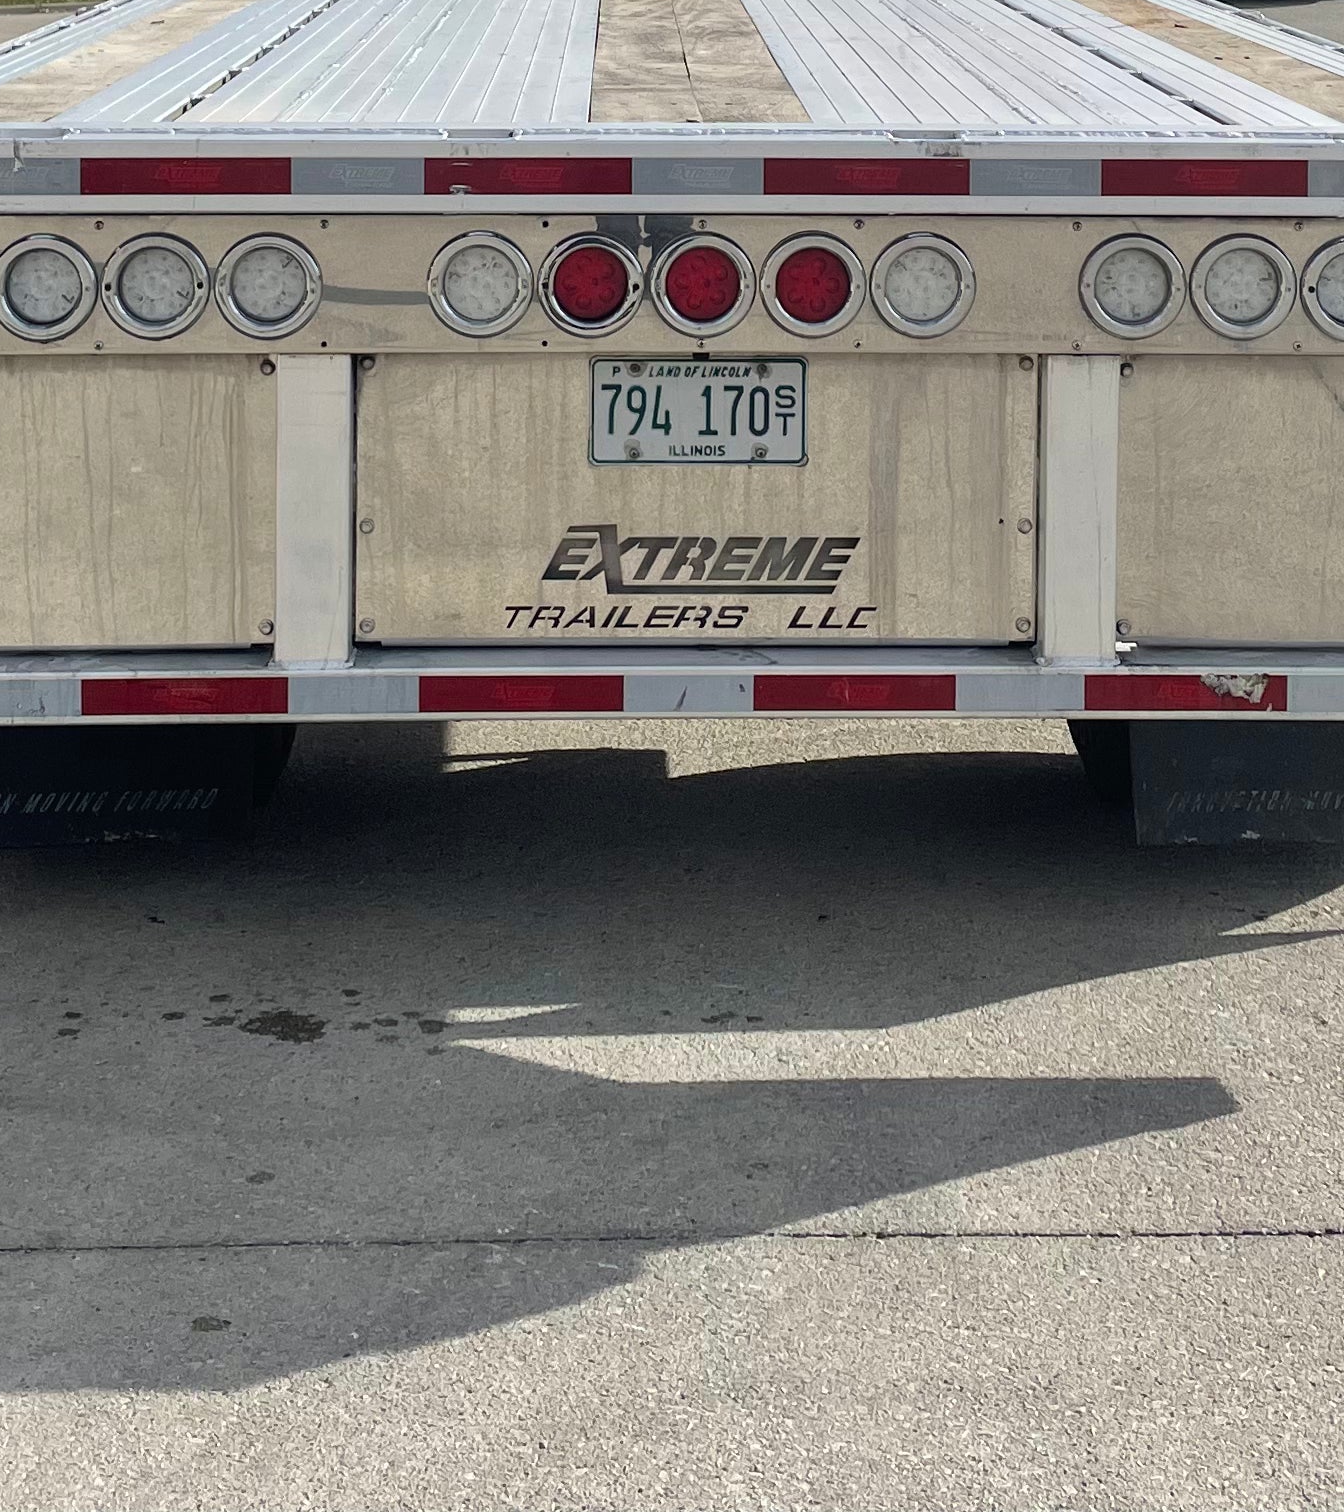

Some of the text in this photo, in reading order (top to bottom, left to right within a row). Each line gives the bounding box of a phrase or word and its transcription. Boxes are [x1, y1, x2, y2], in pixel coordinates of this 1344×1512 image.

[612, 367, 621, 377] P
[649, 366, 752, 378] LAND OF LINCOLN
[601, 384, 770, 436] 794 170
[669, 445, 726, 457] ILLINOIS
[541, 524, 861, 595] EXTREME
[505, 605, 878, 629] TRAILERS LLC
[20, 790, 108, 815] MOVING
[113, 787, 219, 813] FORWARD
